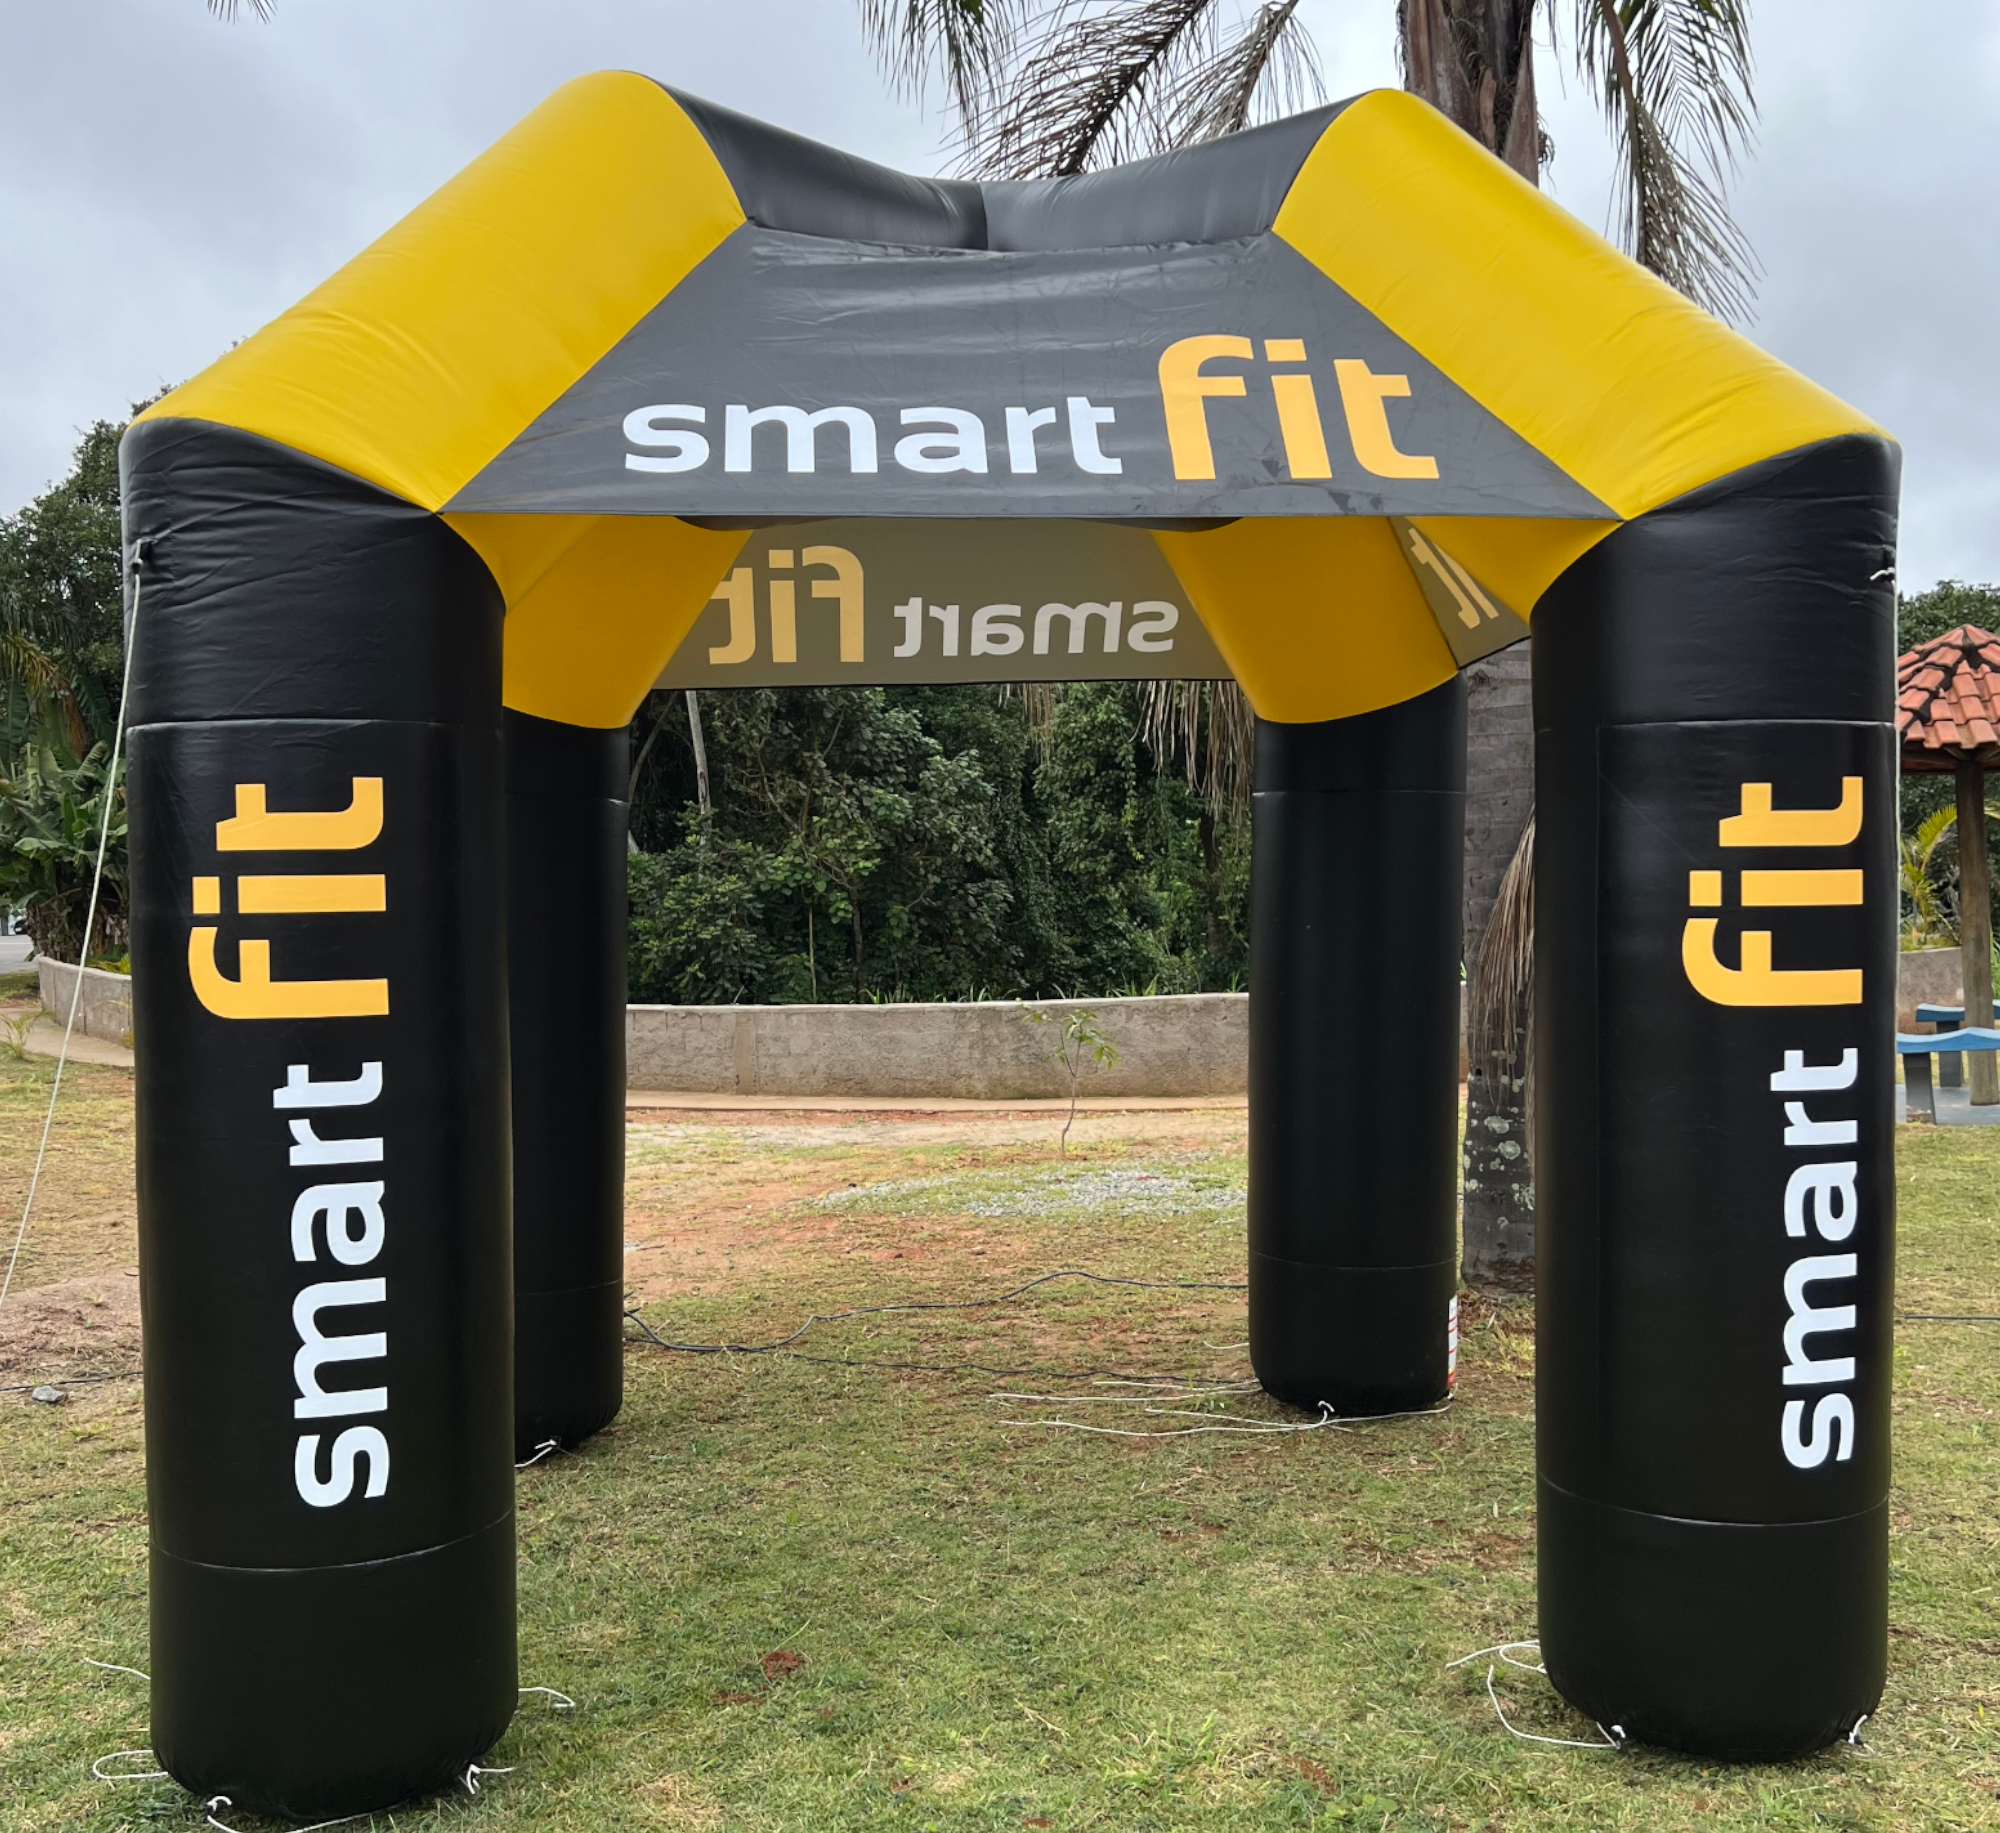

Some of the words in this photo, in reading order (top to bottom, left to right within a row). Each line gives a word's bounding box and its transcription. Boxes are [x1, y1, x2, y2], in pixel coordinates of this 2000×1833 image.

[622, 396, 1123, 475] smart
[1158, 335, 1439, 481] fit
[187, 775, 390, 1020] fit
[1681, 775, 1864, 1007] fit
[273, 1061, 390, 1508] smart
[1770, 1047, 1858, 1469] smart
